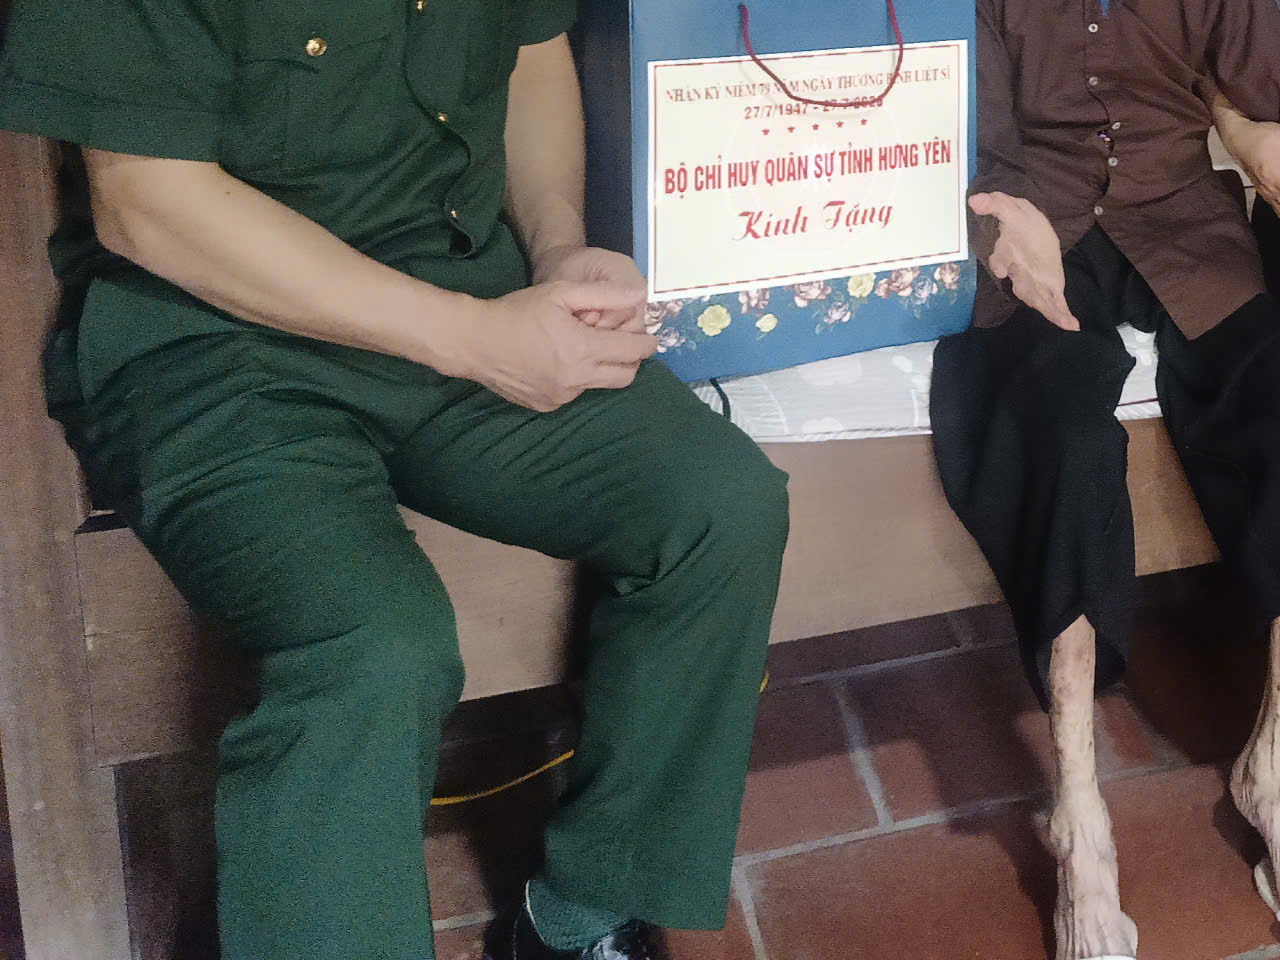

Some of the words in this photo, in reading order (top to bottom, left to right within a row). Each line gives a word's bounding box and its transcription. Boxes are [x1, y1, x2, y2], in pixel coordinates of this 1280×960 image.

[744, 100, 809, 120] 27/7/1947
[665, 161, 688, 199] BỘ
[694, 154, 722, 191] CHỈ
[728, 160, 760, 188] HUY
[765, 152, 808, 186] QUÂN
[814, 150, 836, 182] SỰ
[839, 142, 873, 176] TỈNH
[878, 142, 918, 171] HƯNG
[923, 136, 951, 166] YÊN
